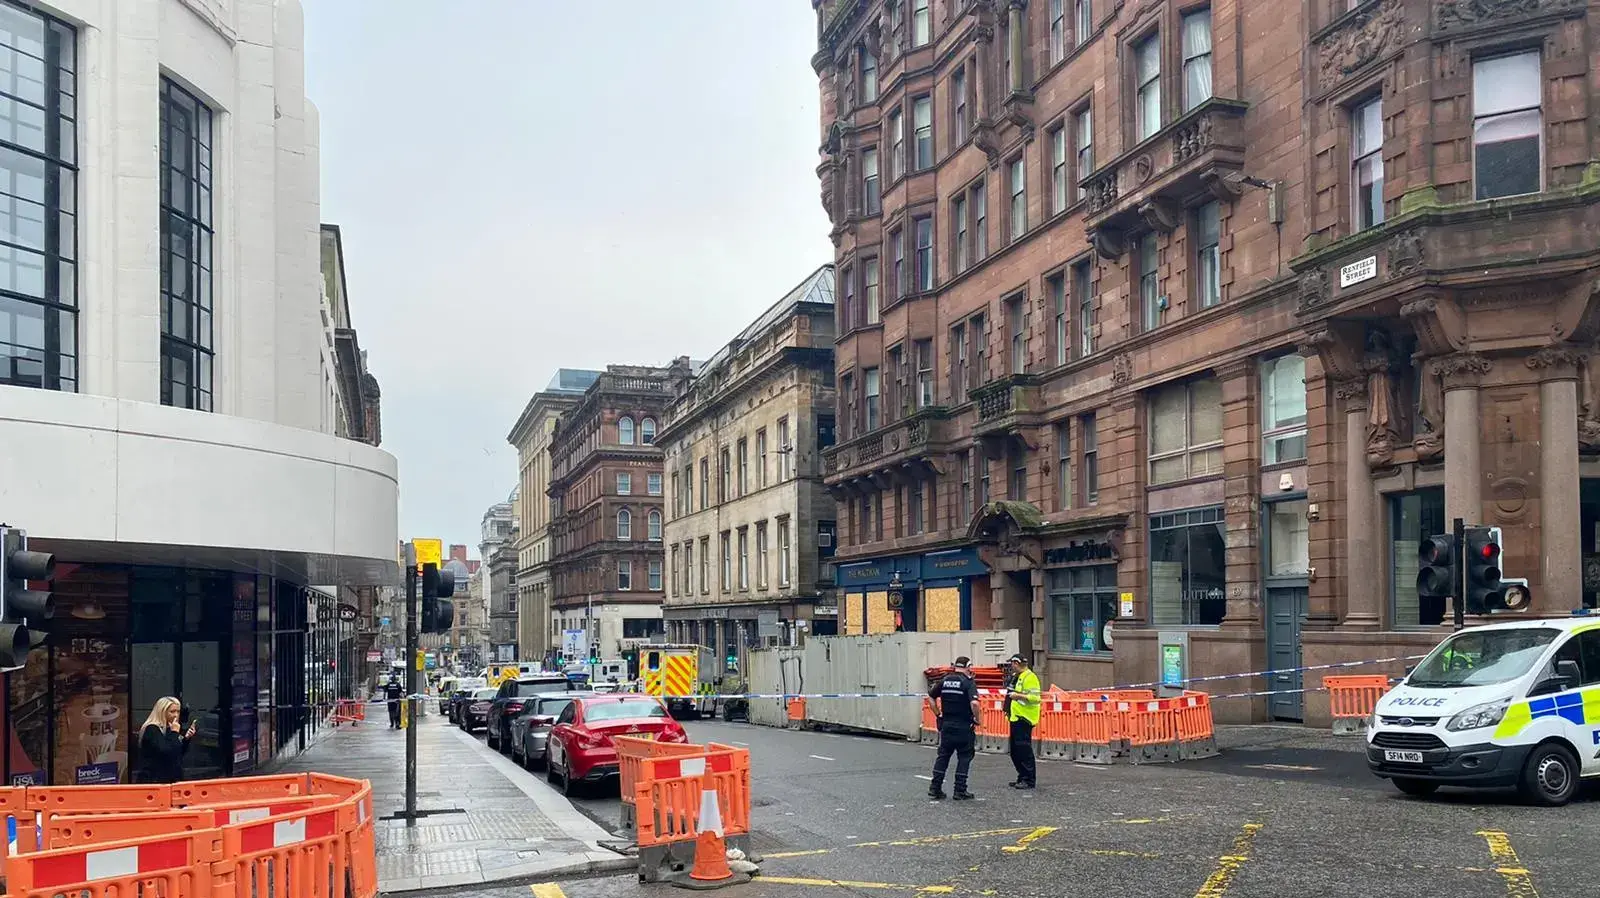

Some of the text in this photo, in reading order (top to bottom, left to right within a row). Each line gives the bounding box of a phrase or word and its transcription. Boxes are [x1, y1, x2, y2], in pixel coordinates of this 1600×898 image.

[1342, 258, 1375, 275] RENFIELD
[1345, 267, 1371, 281] STREET
[943, 680, 961, 689] POLICE
[1388, 697, 1448, 707] POLICE
[1388, 751, 1404, 760] SF14
[78, 767, 101, 778] breck
